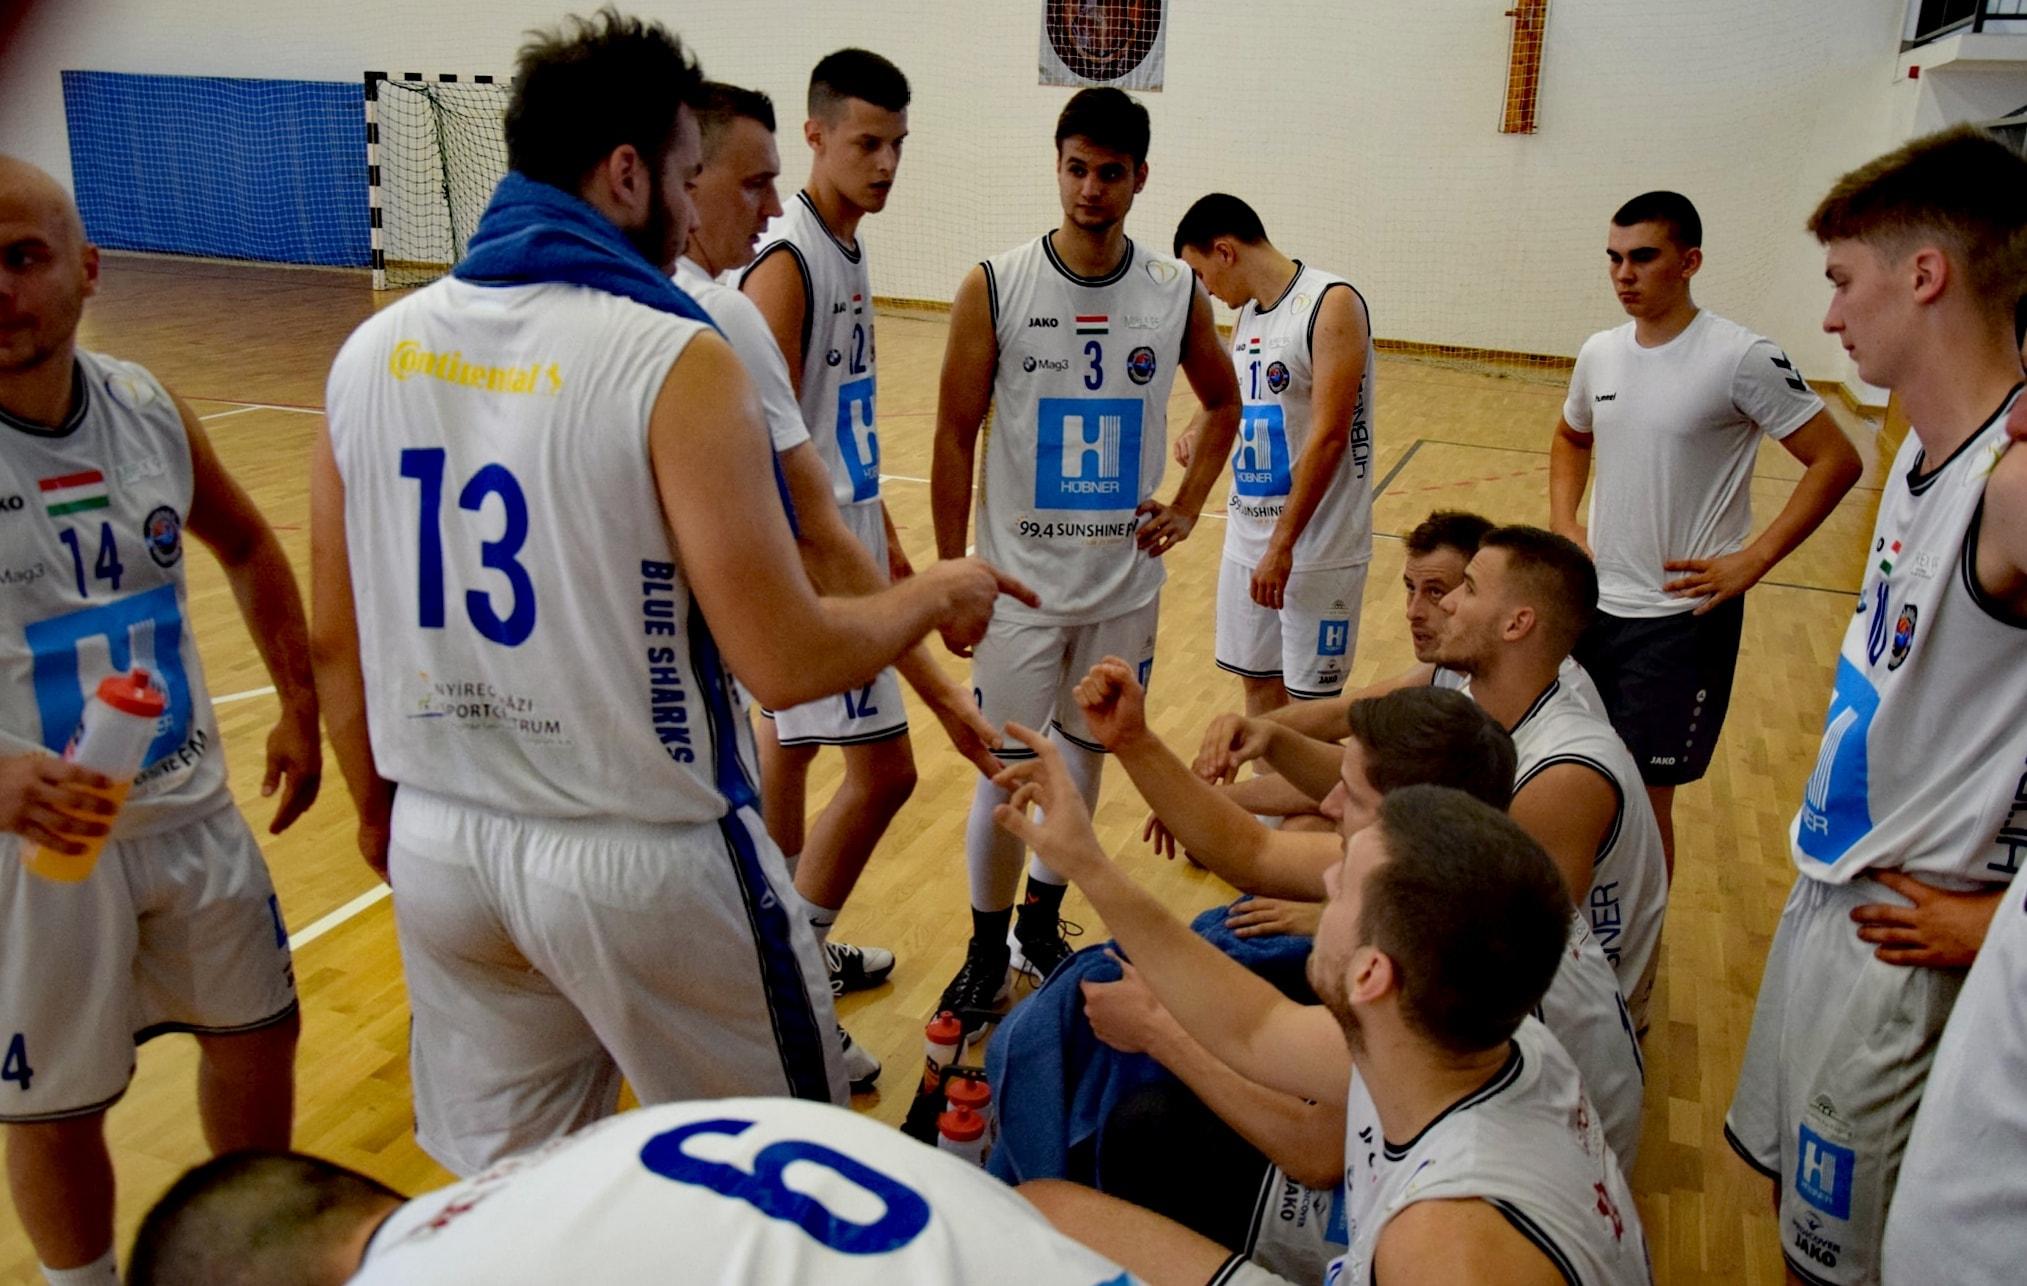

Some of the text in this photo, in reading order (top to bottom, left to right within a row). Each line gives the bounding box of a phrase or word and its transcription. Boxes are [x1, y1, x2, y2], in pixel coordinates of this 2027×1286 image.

[1028, 317, 1059, 328] JAKO
[1038, 358, 1069, 372] Mag3
[1083, 340, 1103, 391] 3
[400, 447, 536, 647] 13
[1020, 520, 1054, 539] 99.4
[1056, 523, 1125, 538] SUNSHINE
[60, 521, 123, 598] 14
[641, 559, 695, 764] BLUE SHARKS
[1650, 756, 1676, 765] JAKO
